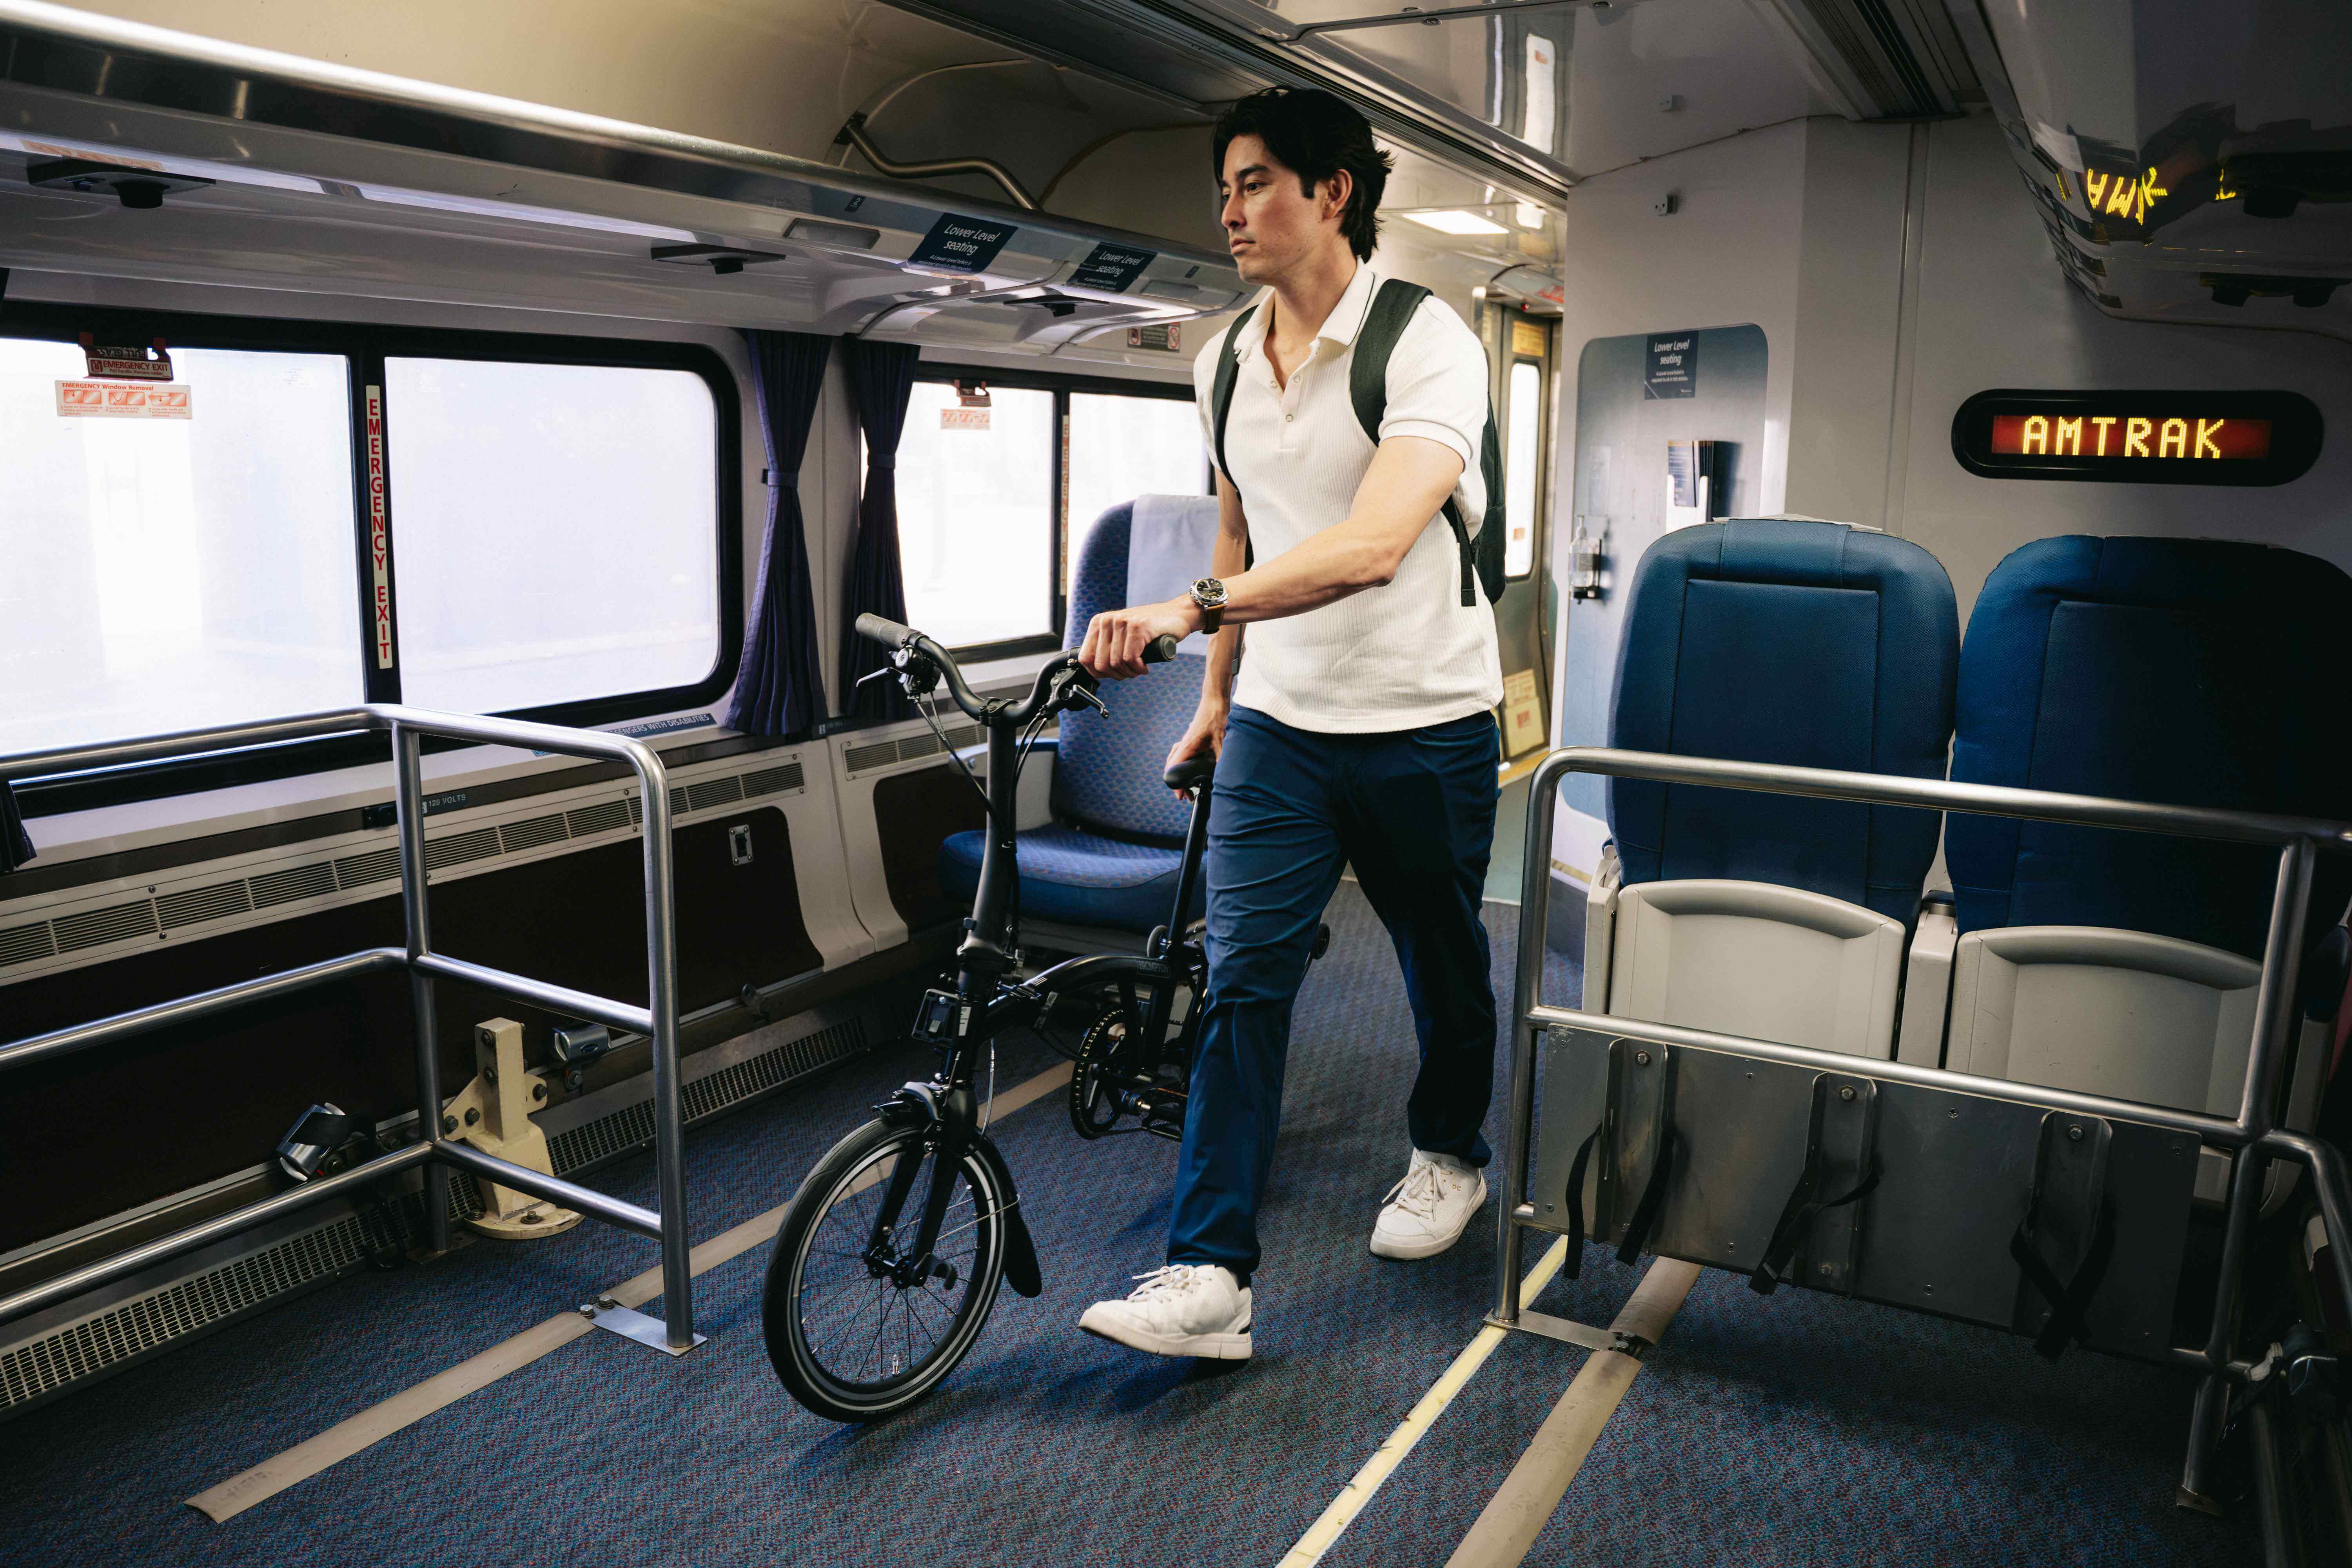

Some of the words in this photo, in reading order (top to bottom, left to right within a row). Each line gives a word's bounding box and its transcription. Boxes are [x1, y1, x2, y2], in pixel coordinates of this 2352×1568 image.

[944, 224, 975, 238] Lower
[973, 230, 1001, 242] Level
[944, 241, 978, 256] seating
[1099, 251, 1124, 261] Lower
[1122, 255, 1144, 265] Level
[1096, 266, 1124, 277] seating
[1654, 343, 1673, 352] Lower
[1673, 339, 1690, 351] Level
[98, 348, 123, 358] GLAS
[1660, 353, 1681, 366] seating
[103, 360, 150, 370] EMERGENCY
[2023, 416, 2224, 458] AMTRAK
[369, 399, 386, 571] EMERGENCY
[377, 586, 390, 659] EXIT
[647, 721, 667, 730] WITH
[667, 714, 710, 727] DISABILITIES
[442, 794, 466, 804] VOLTS
